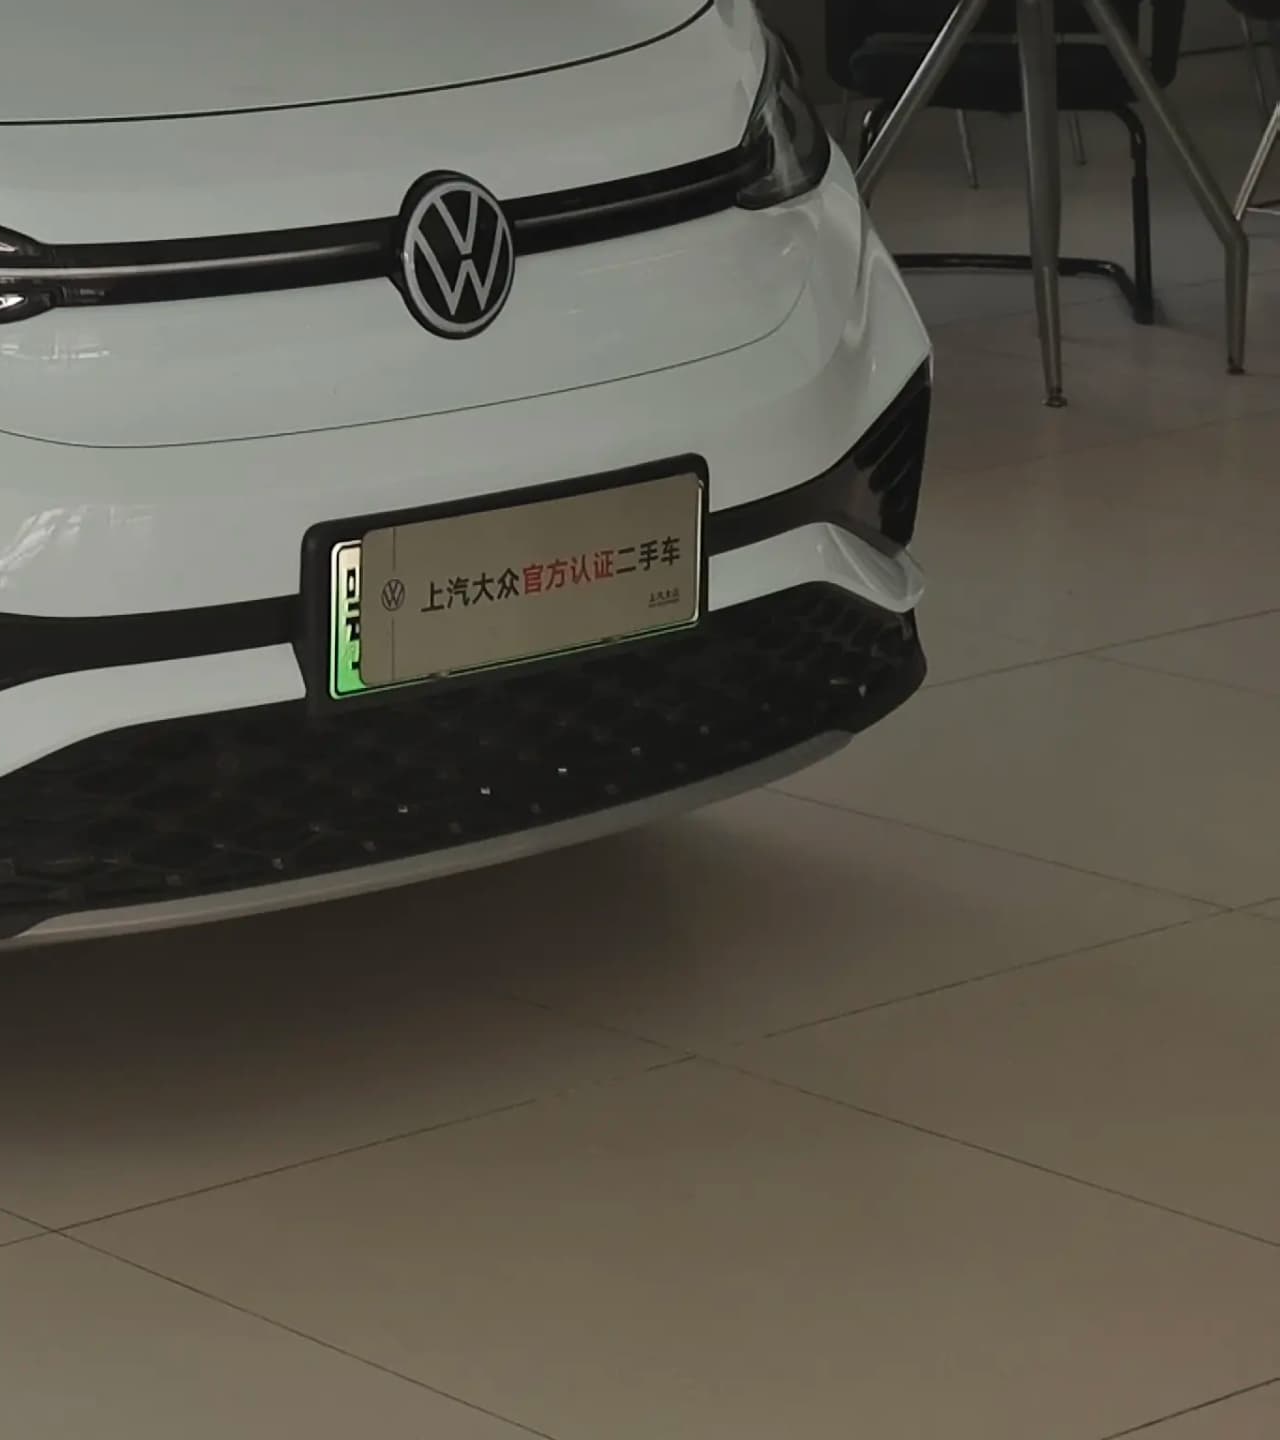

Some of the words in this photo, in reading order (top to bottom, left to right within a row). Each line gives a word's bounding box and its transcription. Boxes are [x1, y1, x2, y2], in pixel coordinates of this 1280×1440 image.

[420, 535, 680, 613] 上汽大众官方认证二手车
